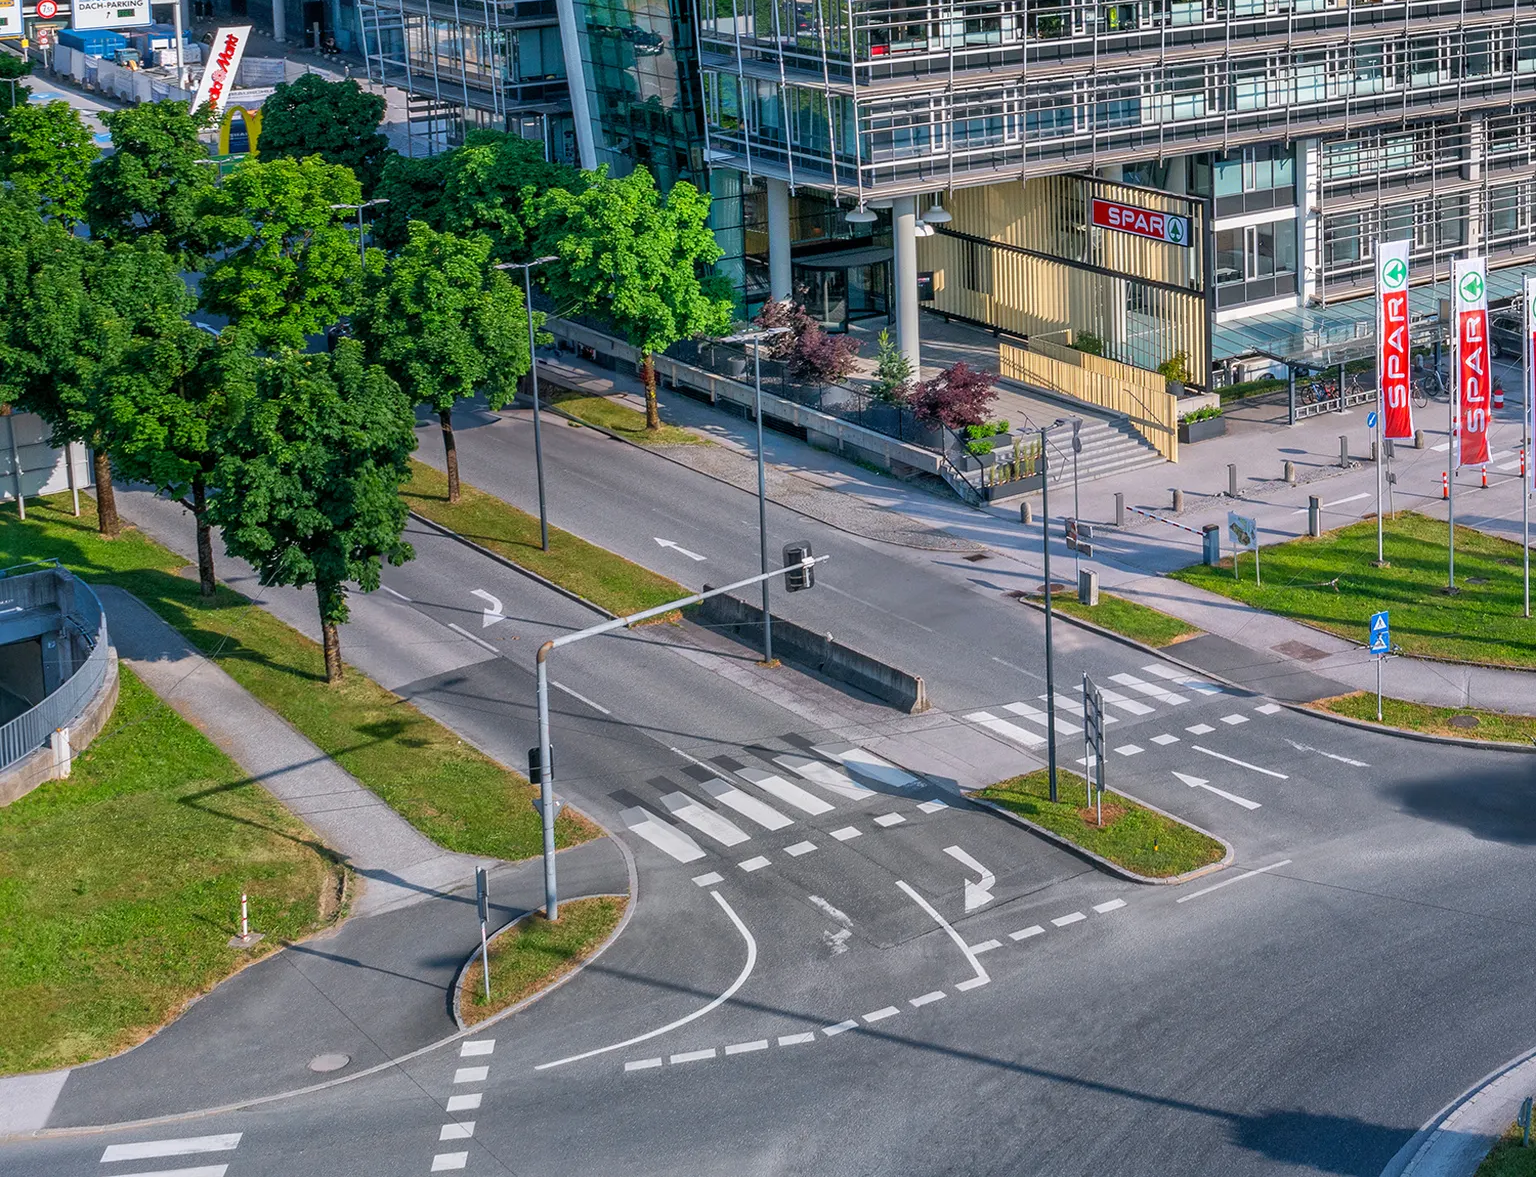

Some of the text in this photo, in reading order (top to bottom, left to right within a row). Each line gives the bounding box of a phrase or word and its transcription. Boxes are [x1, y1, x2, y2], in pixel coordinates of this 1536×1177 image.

[79, 0, 144, 11] DACH-PARKING
[1108, 207, 1163, 235] SPAR
[1387, 296, 1406, 409] SPAR
[1465, 315, 1485, 434] SPAR
